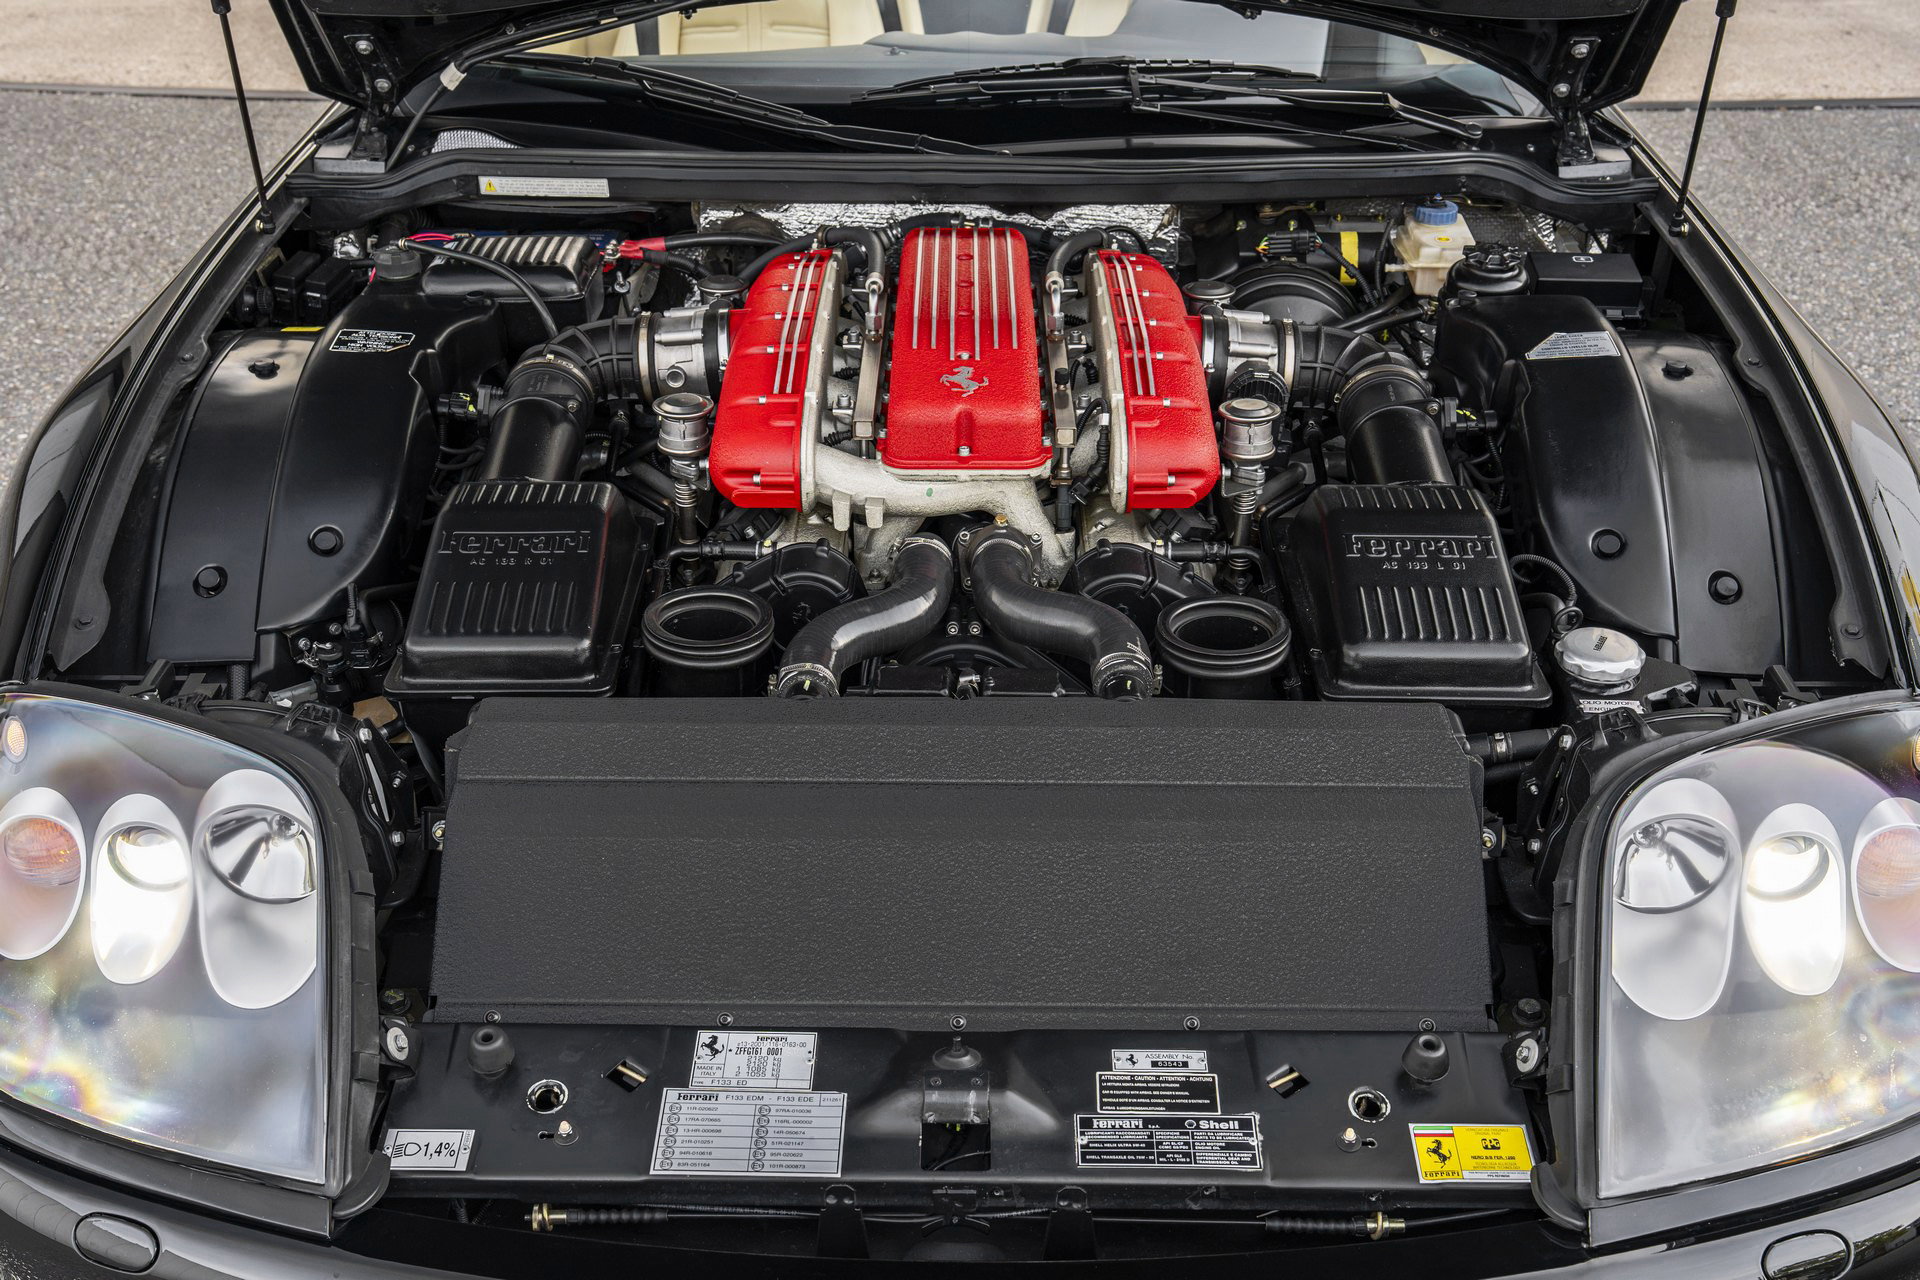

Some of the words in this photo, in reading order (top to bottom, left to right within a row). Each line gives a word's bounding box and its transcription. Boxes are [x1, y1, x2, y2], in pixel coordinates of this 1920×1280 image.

[438, 530, 591, 554] Ferrari
[1343, 534, 1498, 558] Ferrari
[1436, 562, 1444, 570] L
[677, 1093, 719, 1101] Ferrari
[1092, 1119, 1143, 1128] Ferrari
[1199, 1120, 1239, 1129] Shell
[1481, 1138, 1500, 1150] PPG
[423, 1142, 456, 1160] 1,4%
